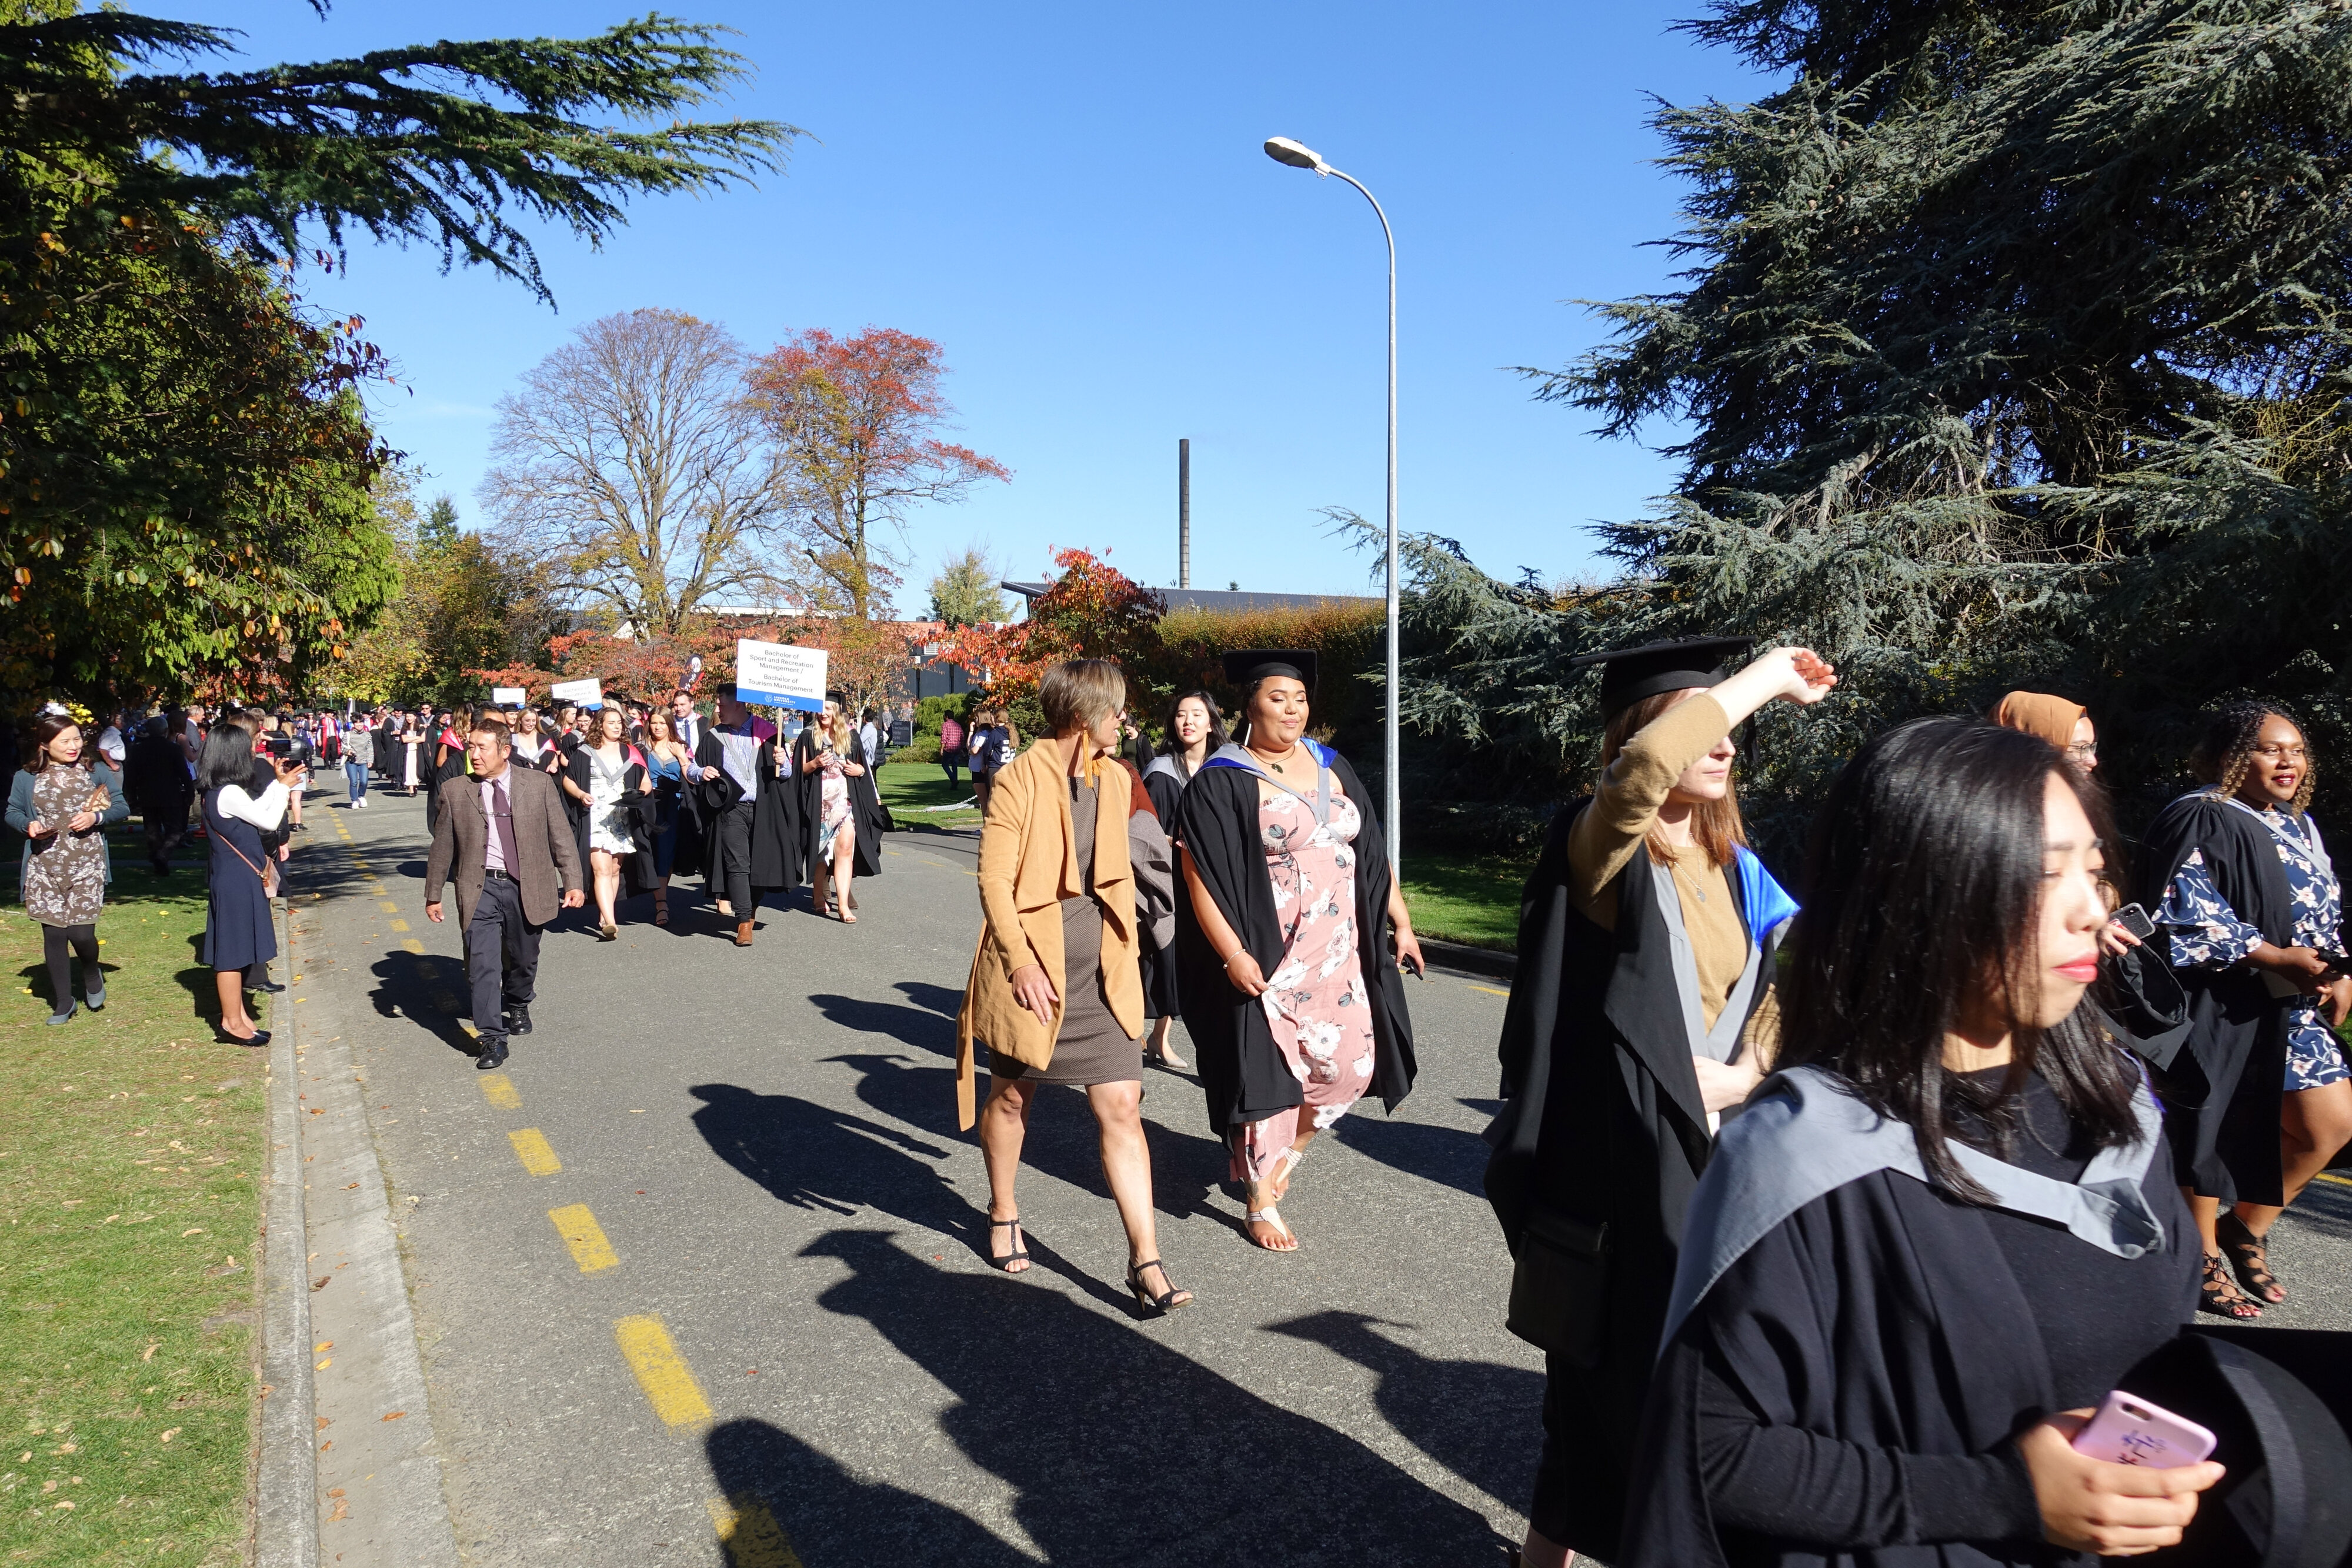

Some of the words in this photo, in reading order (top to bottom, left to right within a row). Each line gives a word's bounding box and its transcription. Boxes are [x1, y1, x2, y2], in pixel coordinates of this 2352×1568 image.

[765, 649, 791, 658] Bachelor
[759, 663, 799, 673] Management
[781, 659, 813, 668] Recreation
[764, 674, 790, 683] Bachelor
[748, 679, 772, 687] Tourism
[773, 682, 813, 693] Management
